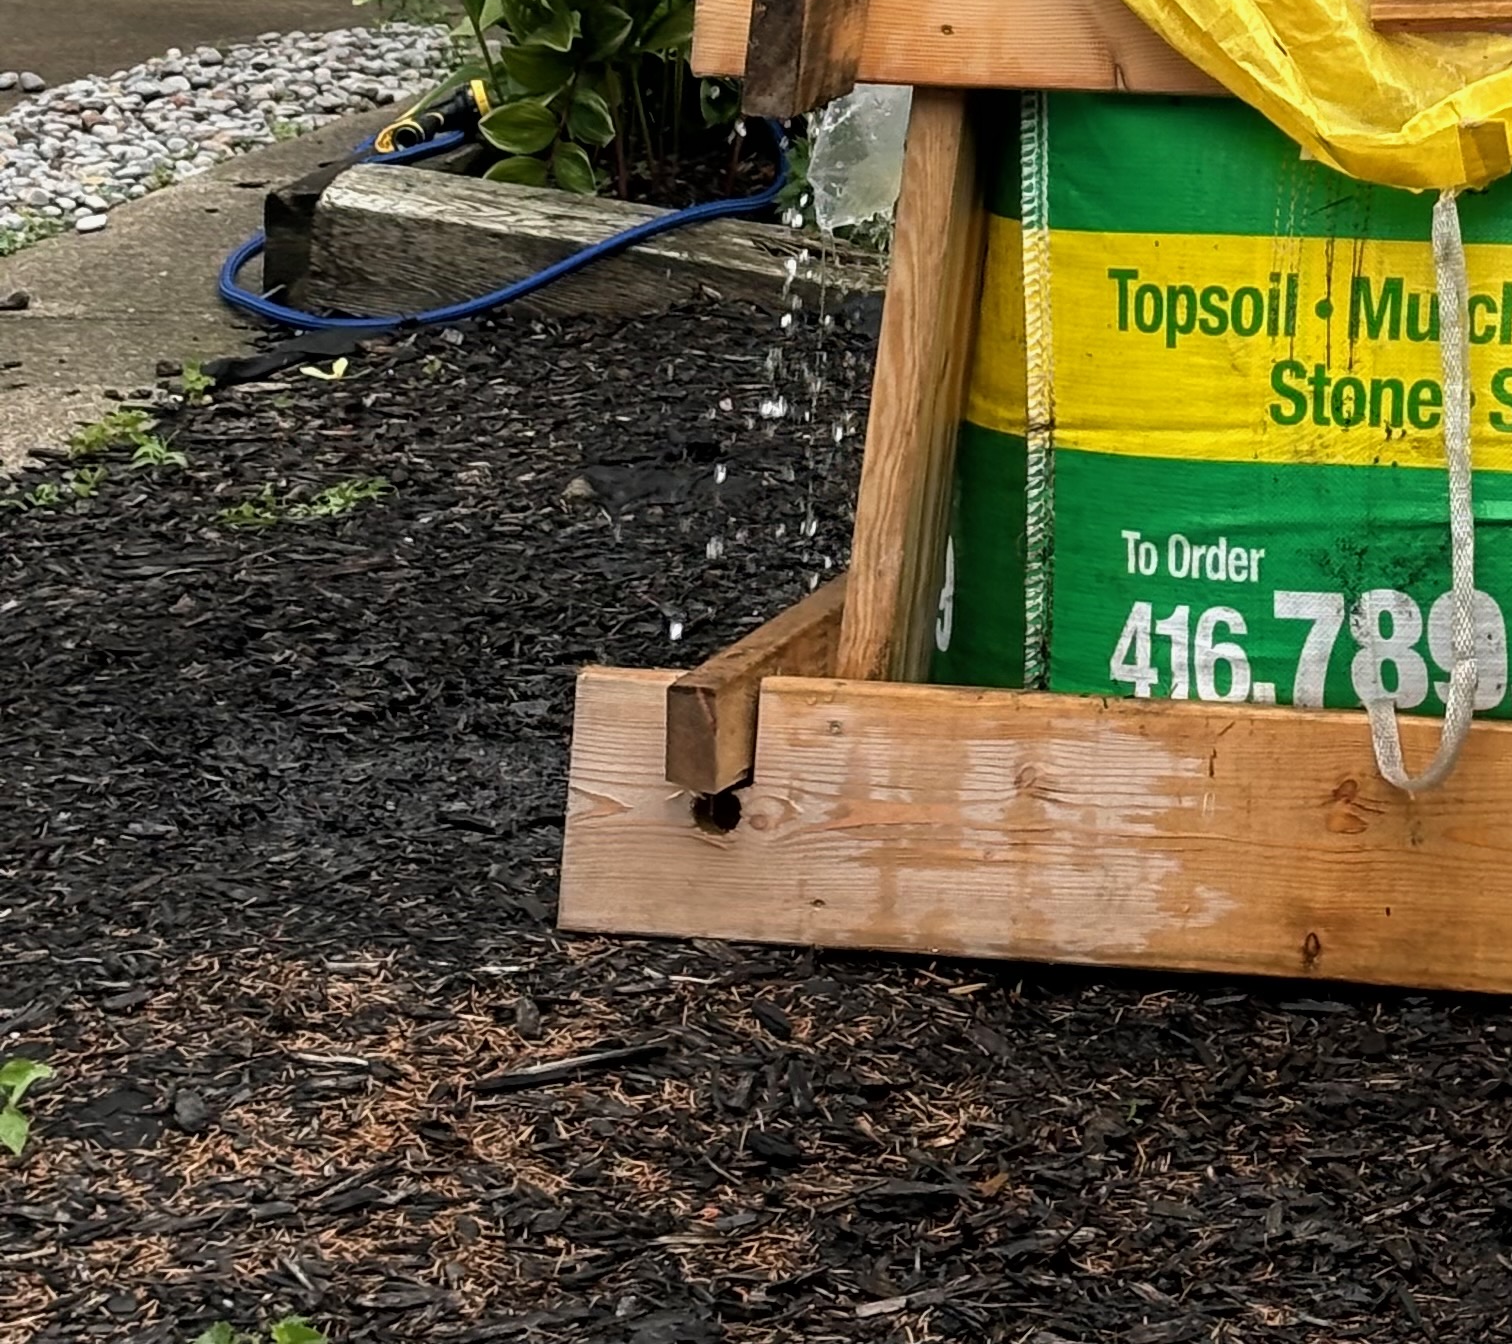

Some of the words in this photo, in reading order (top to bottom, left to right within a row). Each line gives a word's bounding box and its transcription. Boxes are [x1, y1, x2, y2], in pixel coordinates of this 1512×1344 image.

[1107, 268, 1299, 349] Topsoil
[1269, 360, 1443, 428] Stone
[1121, 530, 1158, 576] To
[1167, 534, 1266, 584] Order
